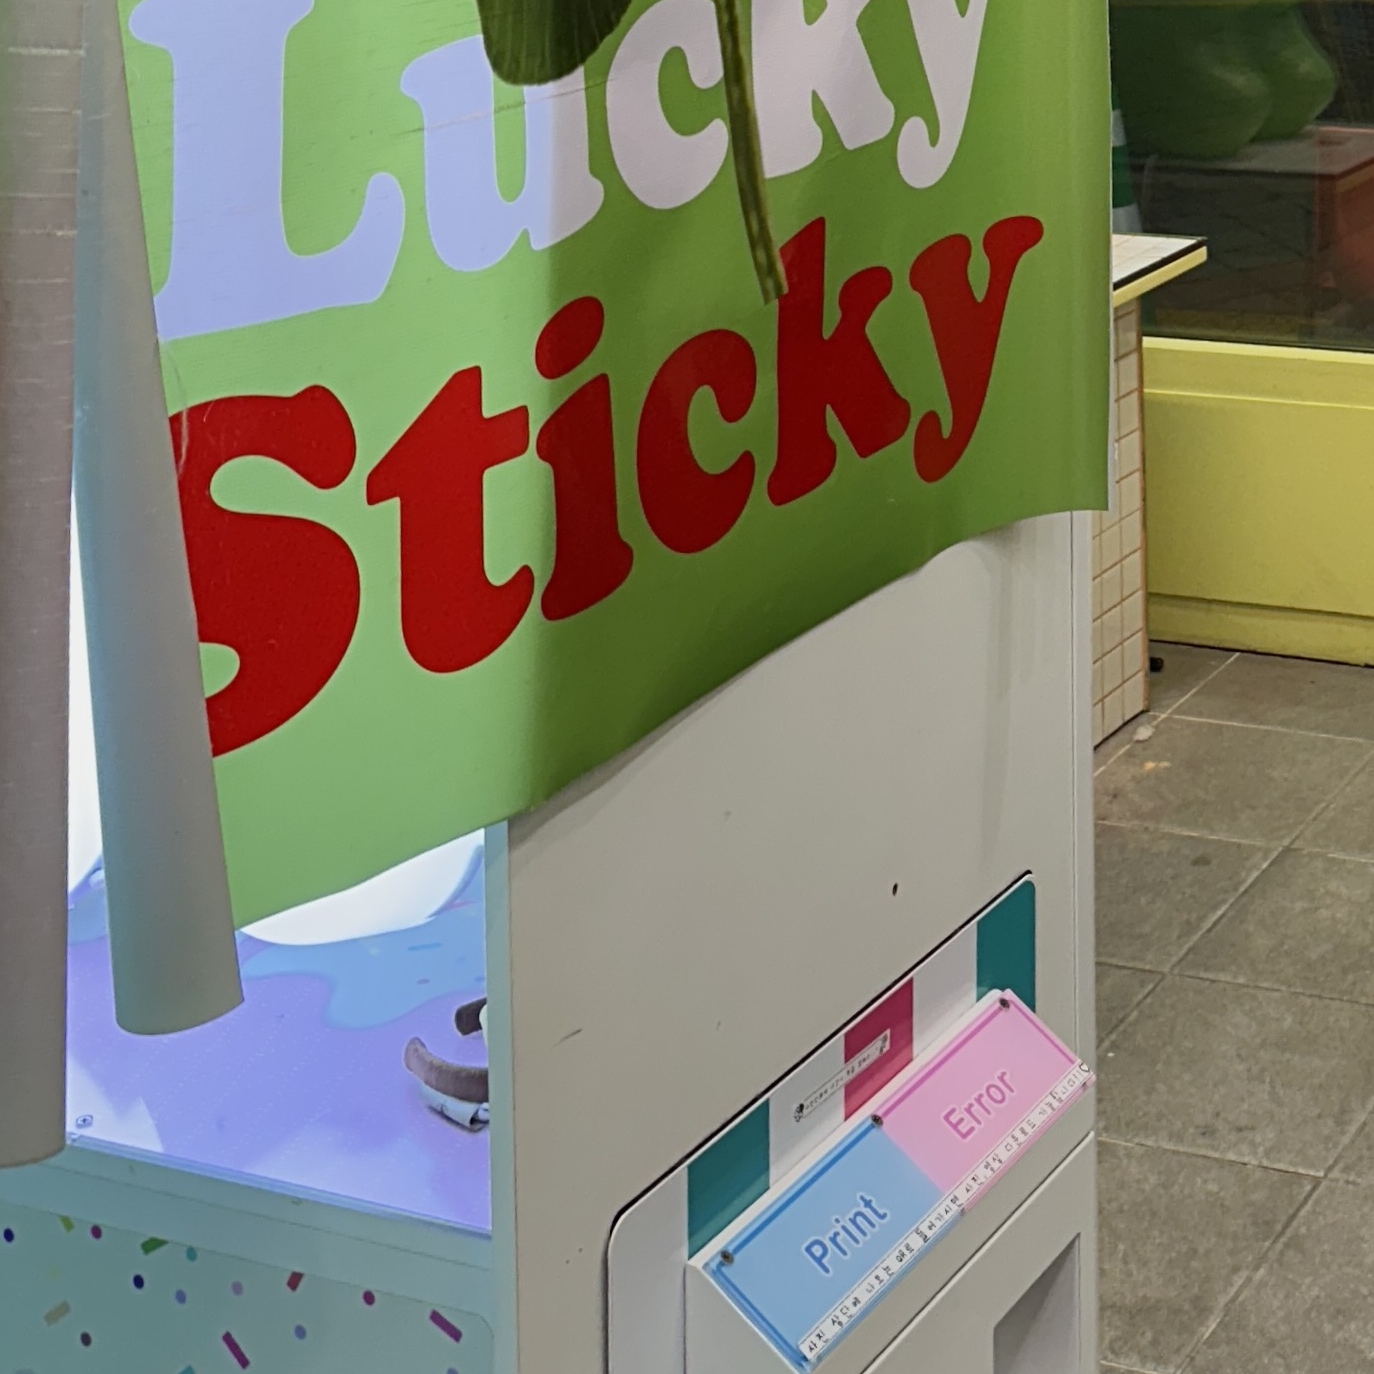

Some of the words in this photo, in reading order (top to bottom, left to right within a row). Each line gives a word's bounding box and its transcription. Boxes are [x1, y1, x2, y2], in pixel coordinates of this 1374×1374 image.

[168, 215, 1044, 758] Sticky
[943, 1071, 1014, 1140] Error
[804, 1193, 888, 1275] Print
[808, 1329, 830, 1353] 사진
[831, 1296, 861, 1327] 상단에
[865, 1265, 895, 1287] 나오는
